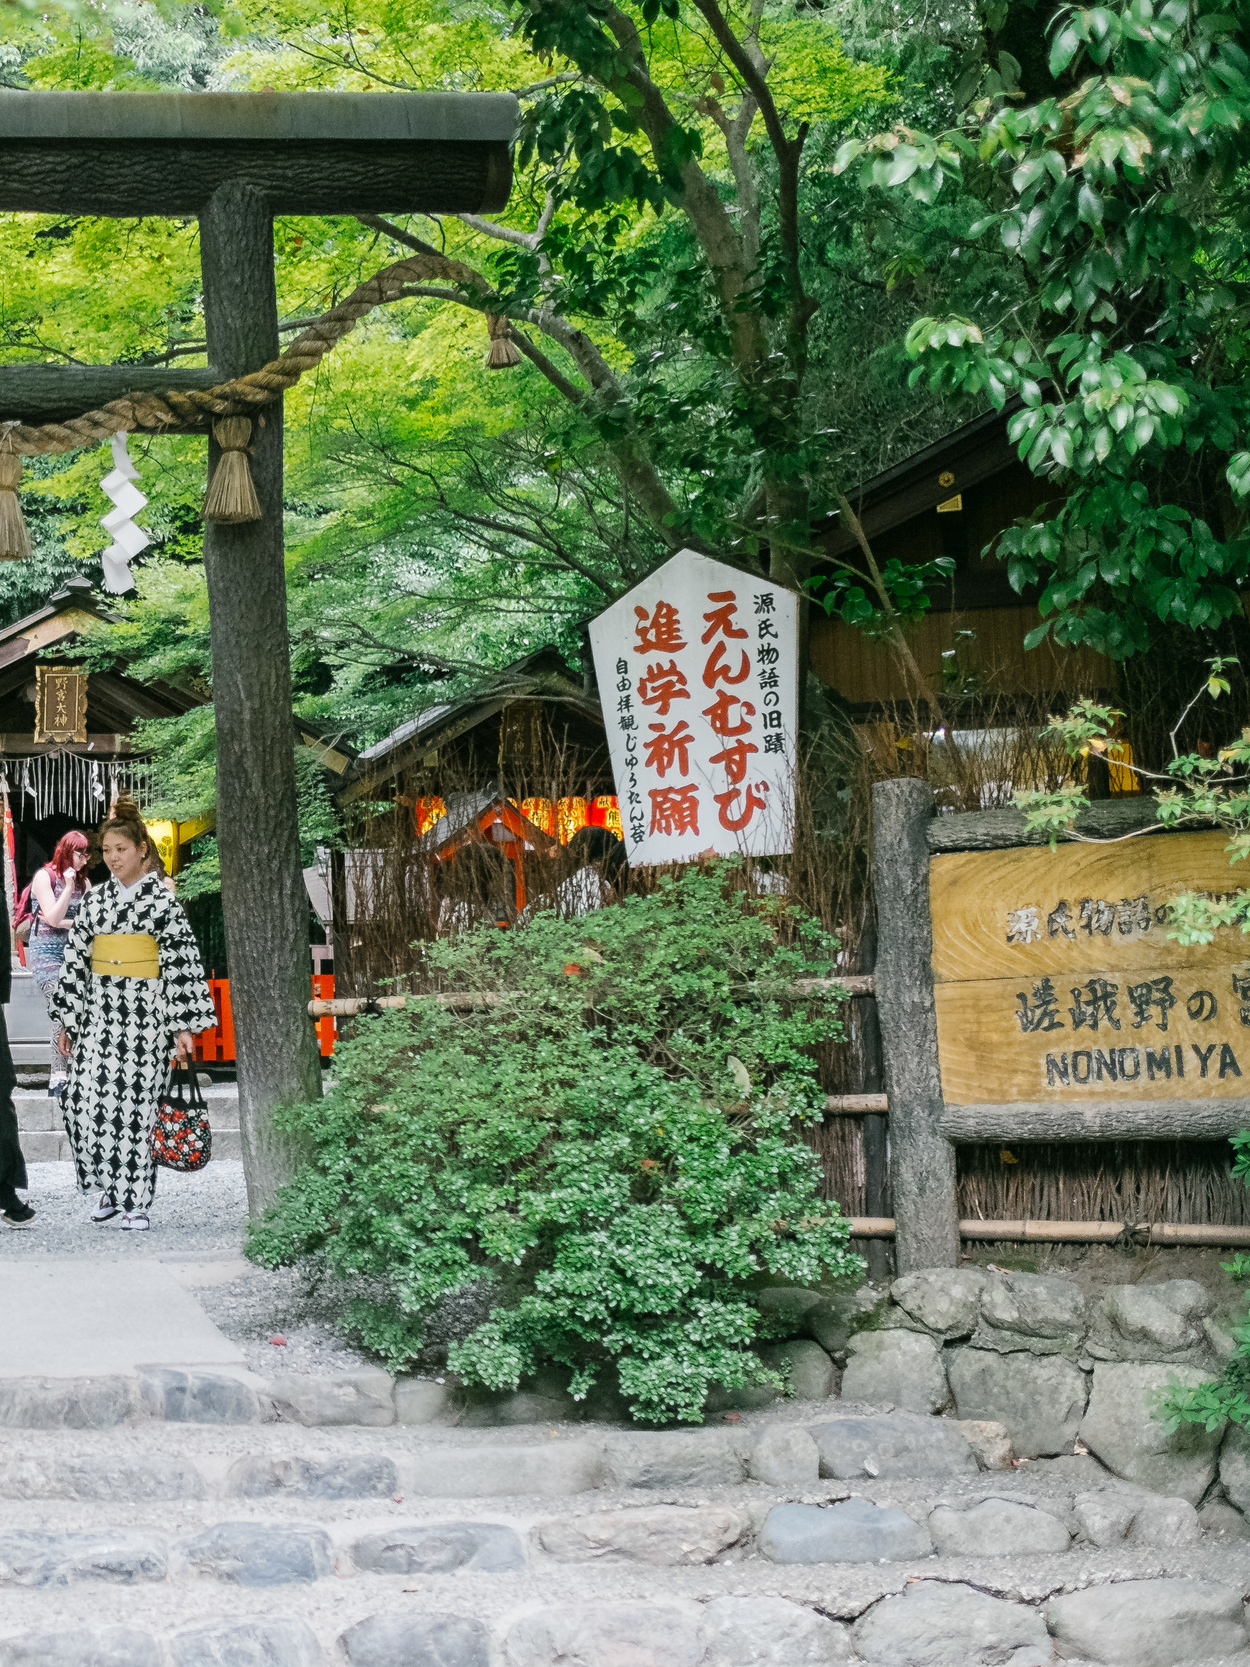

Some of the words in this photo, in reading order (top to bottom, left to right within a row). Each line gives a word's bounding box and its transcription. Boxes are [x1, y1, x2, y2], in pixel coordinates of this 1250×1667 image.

[53, 677, 69, 727] 野宮大神
[633, 600, 700, 838] 進学祈願
[701, 590, 770, 832] えんむすび
[753, 592, 786, 754] 源氏物語の旧蹟
[1045, 1043, 1243, 1087] NONOMIYA
